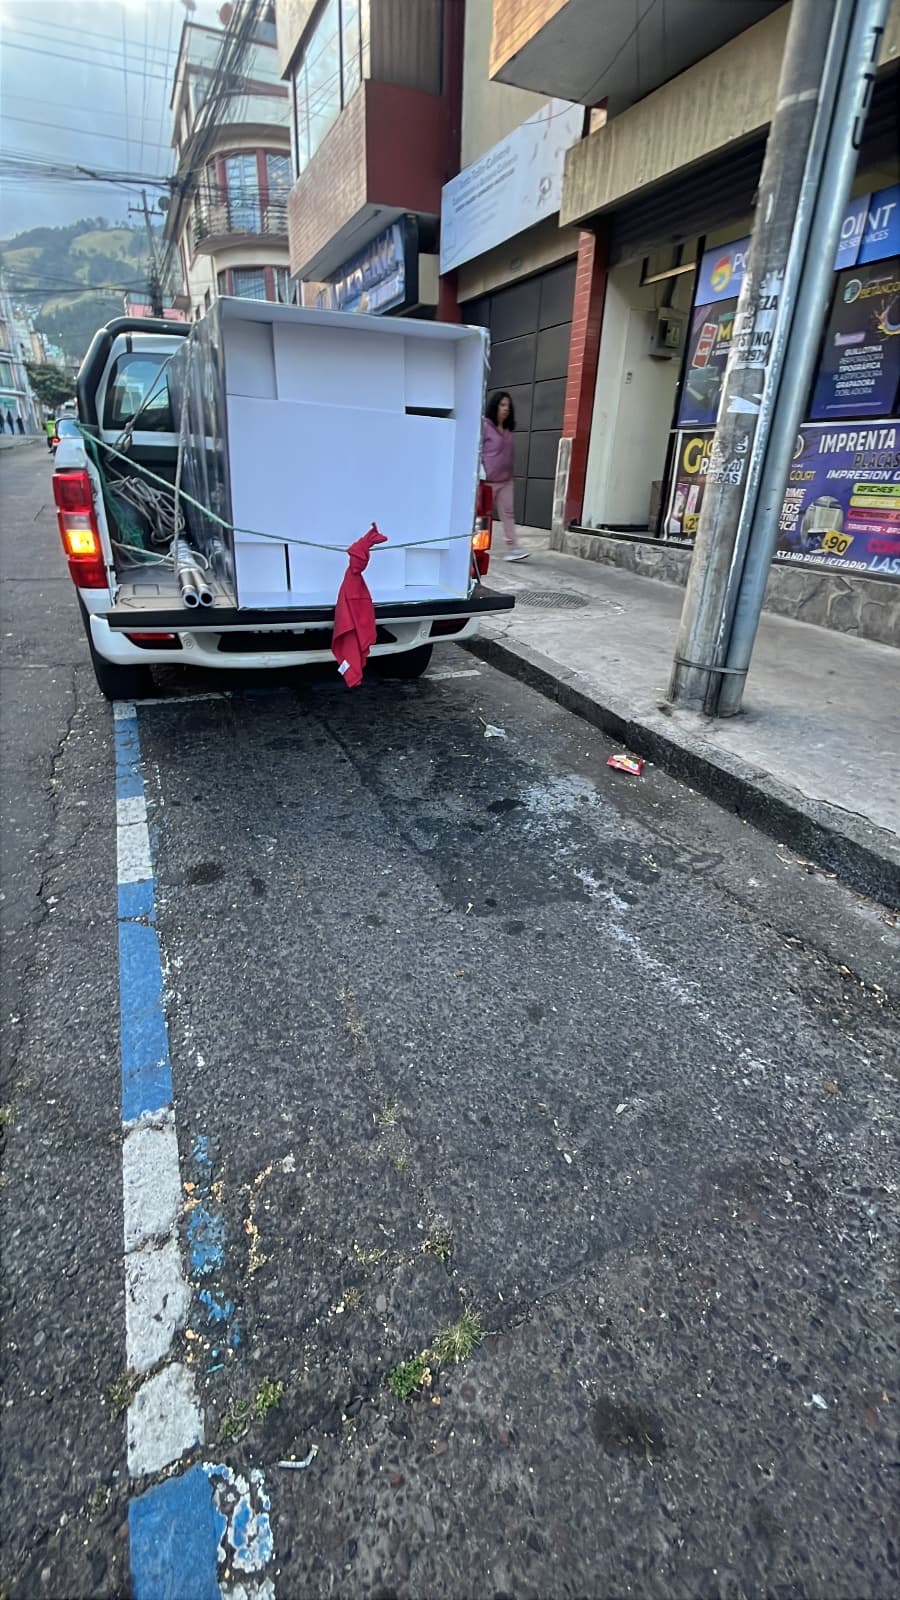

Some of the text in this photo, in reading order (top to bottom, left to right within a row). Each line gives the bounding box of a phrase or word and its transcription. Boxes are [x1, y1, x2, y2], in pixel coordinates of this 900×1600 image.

[841, 203, 896, 238] OINT
[818, 428, 896, 453] IMPRENTA
[854, 451, 900, 469] PLACAS
[790, 471, 817, 480] COURT
[826, 469, 892, 480] IMPRESION
[775, 550, 803, 561] STAND
